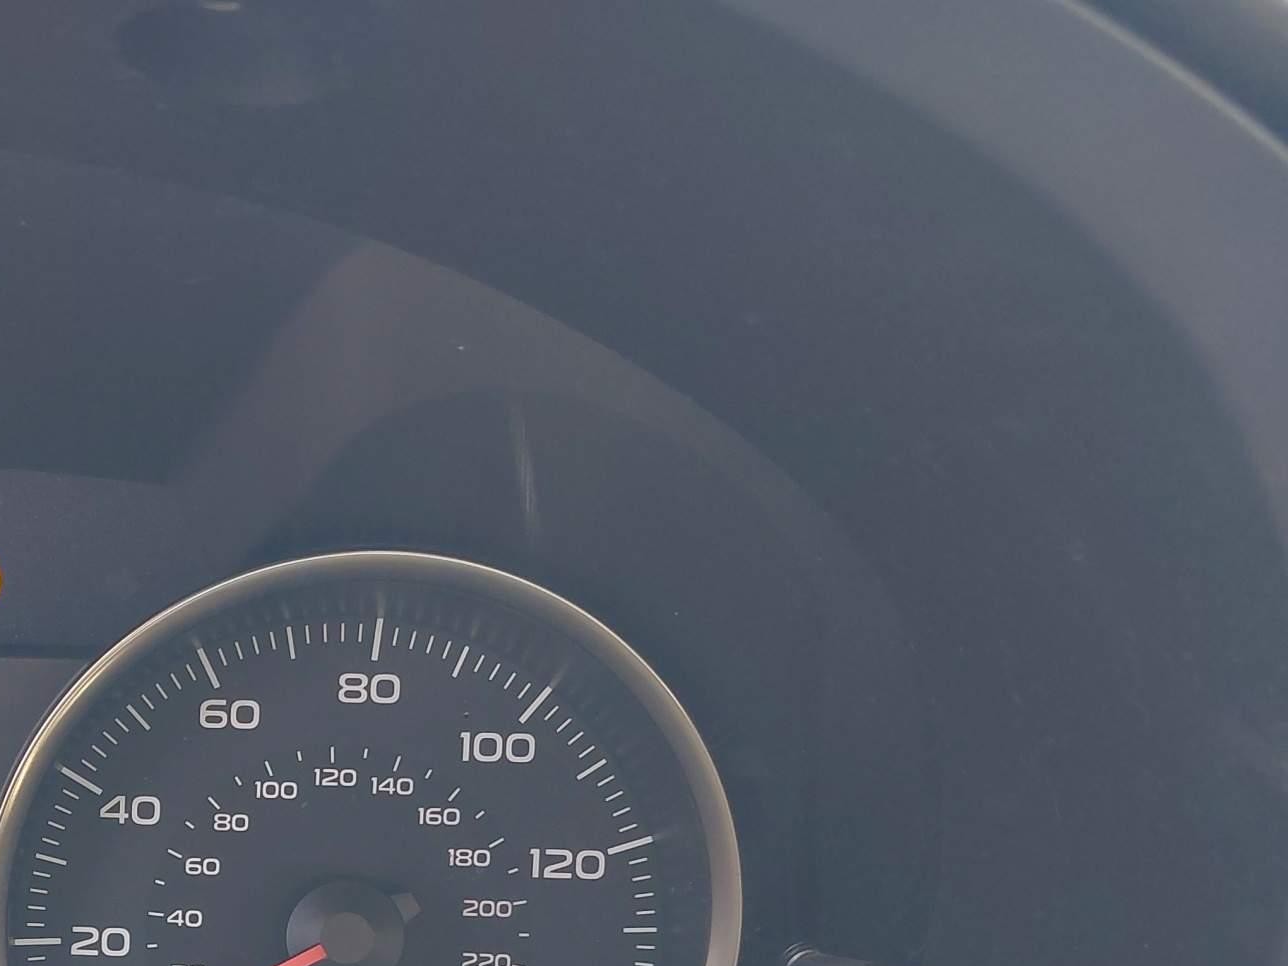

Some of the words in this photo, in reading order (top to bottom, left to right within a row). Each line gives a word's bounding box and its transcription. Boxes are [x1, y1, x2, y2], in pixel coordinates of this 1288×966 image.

[338, 674, 401, 704] 80
[199, 699, 260, 730] 60
[459, 731, 536, 763] 100
[314, 768, 357, 787] 120
[371, 777, 414, 795] 140
[254, 781, 298, 799] 100
[99, 796, 161, 826] 40
[418, 807, 461, 826] 160
[213, 811, 249, 831] 80
[185, 857, 220, 876] 60
[448, 848, 491, 867] 180
[529, 848, 606, 880] 120
[166, 909, 203, 928] 40
[462, 900, 511, 918] 200
[70, 926, 131, 957] 20
